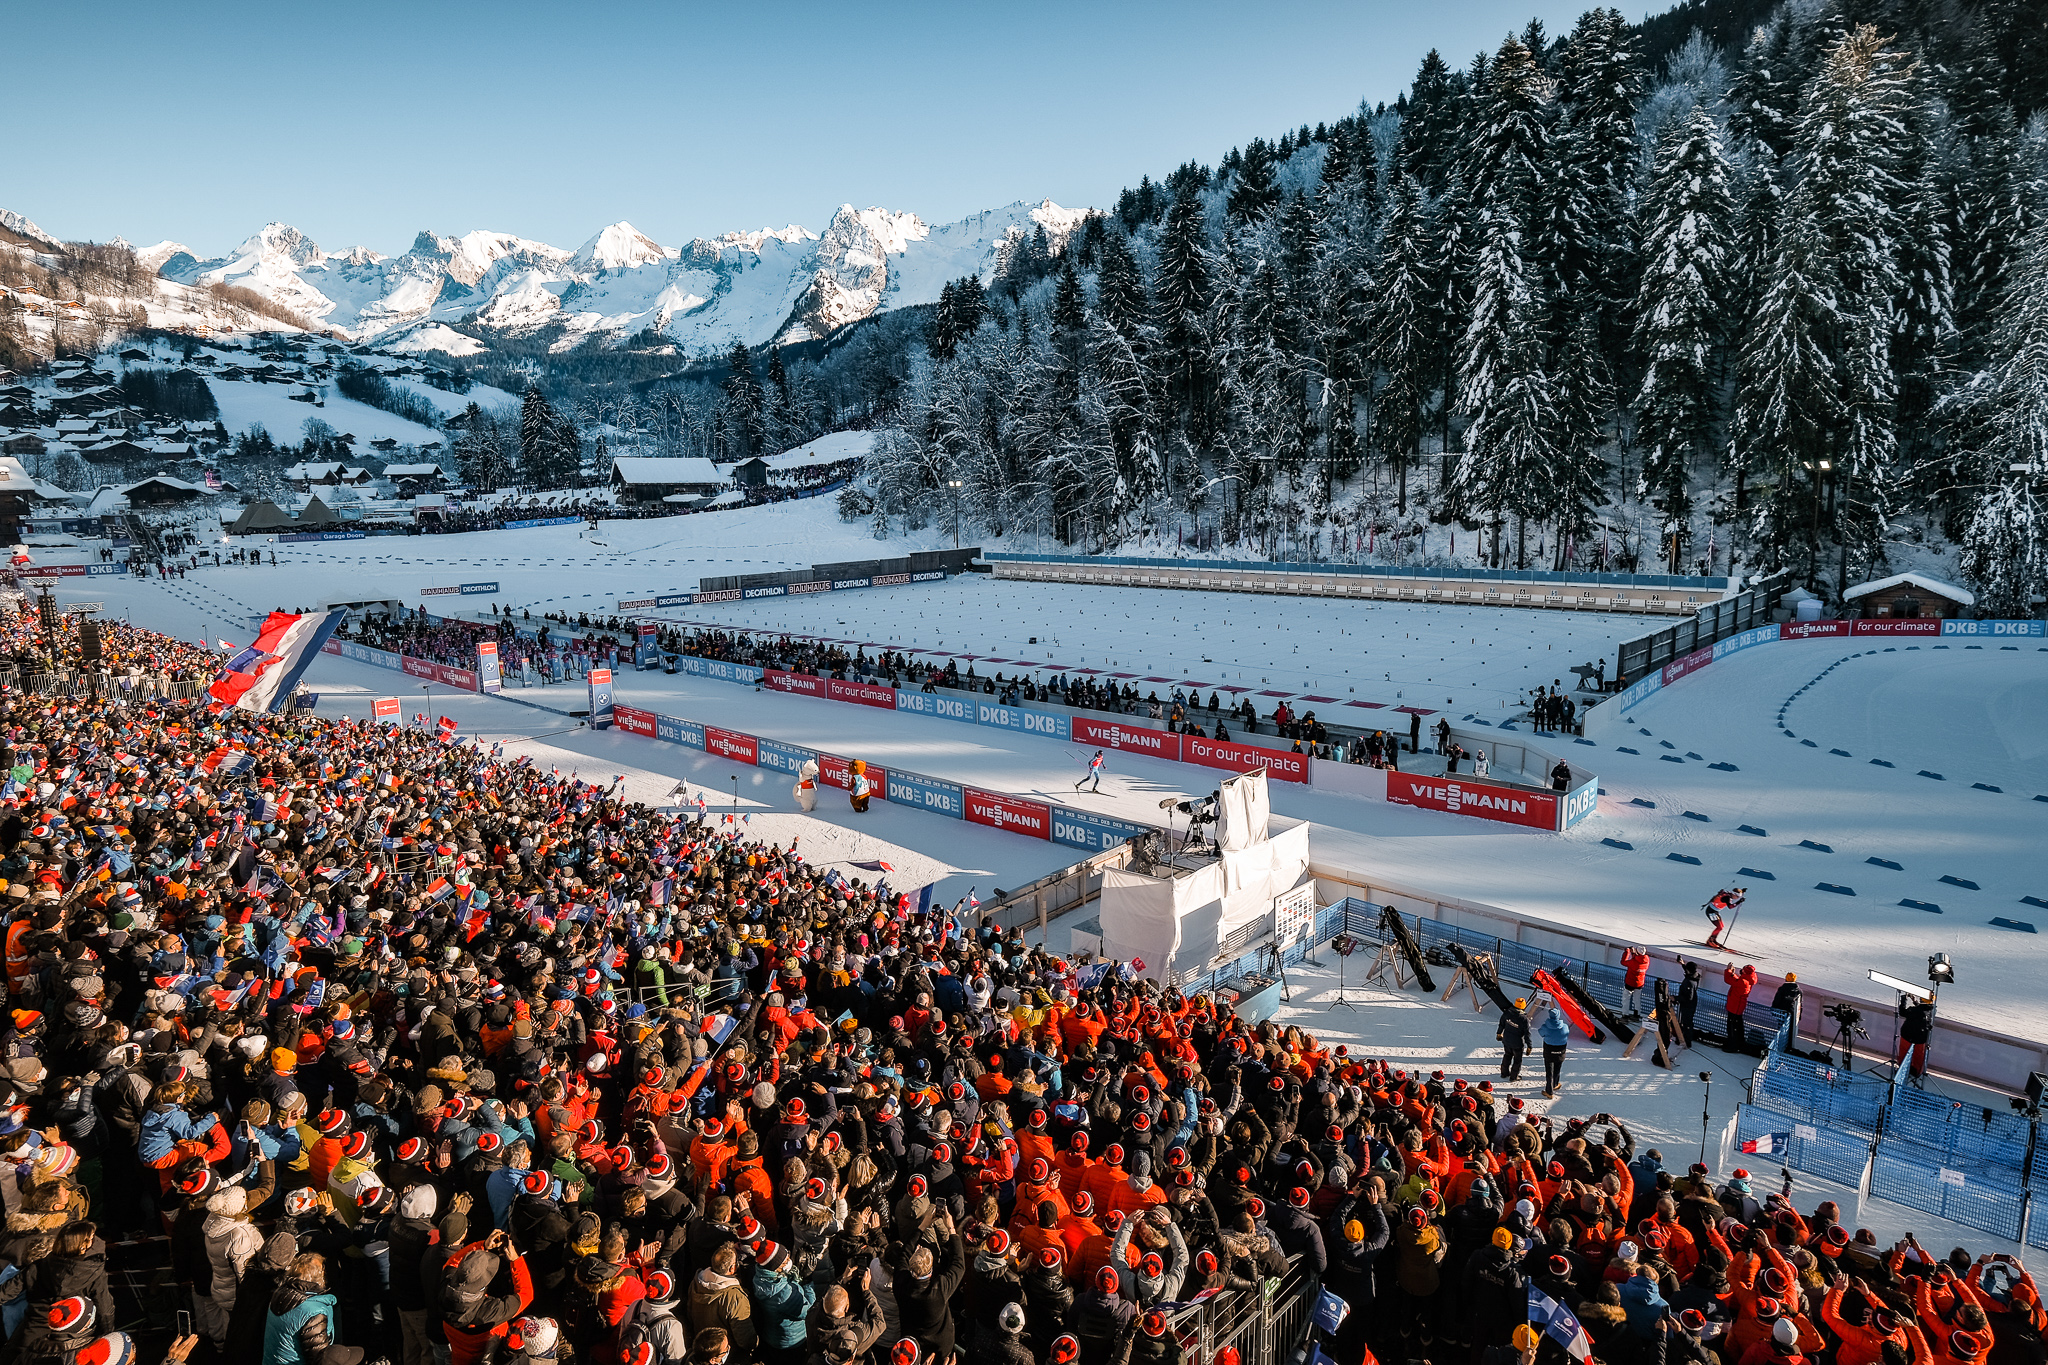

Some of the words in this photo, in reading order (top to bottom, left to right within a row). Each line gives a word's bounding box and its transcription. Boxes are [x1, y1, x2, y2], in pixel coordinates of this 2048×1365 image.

[44, 567, 84, 575] VIESSMANN
[90, 565, 113, 574] DKB
[421, 587, 460, 595] BAUHAUS
[463, 584, 496, 592] DECATHLON
[620, 600, 656, 609] BAUHAUS
[659, 596, 689, 605] DECATHLON
[693, 590, 741, 602] BAUHAUS
[745, 587, 784, 597] DECATHLON
[789, 582, 831, 593] BAUHAUS
[835, 579, 868, 589] DECATHLON
[873, 575, 910, 585] BAUHAUS
[913, 572, 944, 581] DECATHLON
[1789, 623, 1837, 637] VIESSMANN
[1857, 622, 1872, 631] for
[1895, 622, 1935, 631] climate
[1945, 622, 1977, 634] DKB
[1994, 623, 2028, 634] DKB
[1740, 634, 1750, 647] DKB
[1757, 628, 1772, 642] DKB
[356, 647, 366, 660] DKB
[1725, 641, 1735, 654] DKB
[371, 651, 381, 664] DKB
[386, 655, 397, 668] DKB
[1700, 650, 1712, 662] climate
[406, 661, 431, 675] VIESSMANN
[683, 659, 699, 672] DKB
[709, 663, 727, 677] DKB
[442, 670, 470, 684] VIESSMANN
[736, 667, 754, 682] DKB
[772, 675, 815, 691] VIESSMANN
[1649, 677, 1658, 691] DKB
[832, 682, 842, 694] for
[845, 688, 859, 697] our
[860, 689, 892, 702] climate
[1636, 684, 1645, 700] DKB
[899, 693, 924, 711] DKB
[937, 699, 964, 717] DKB
[1622, 693, 1633, 710] DKB
[617, 715, 652, 731] VIESSMANN
[980, 706, 1009, 725] DKB
[1025, 713, 1055, 734] DKB
[659, 725, 674, 738] DKB
[681, 730, 697, 744] DKB
[1087, 726, 1161, 749] VIESSMANN
[710, 739, 752, 757] VIESSMANN
[761, 750, 779, 766] DKB
[1192, 741, 1212, 757] for
[1216, 747, 1240, 763] our
[1243, 751, 1300, 773] climate
[890, 783, 913, 800] DKB
[925, 791, 950, 810] DKB
[1410, 784, 1527, 815] VIESSMANN
[1569, 790, 1589, 820] DKB
[973, 804, 1040, 829] VIESSMANN
[1055, 822, 1086, 843] DKB
[1102, 833, 1126, 849] DK
